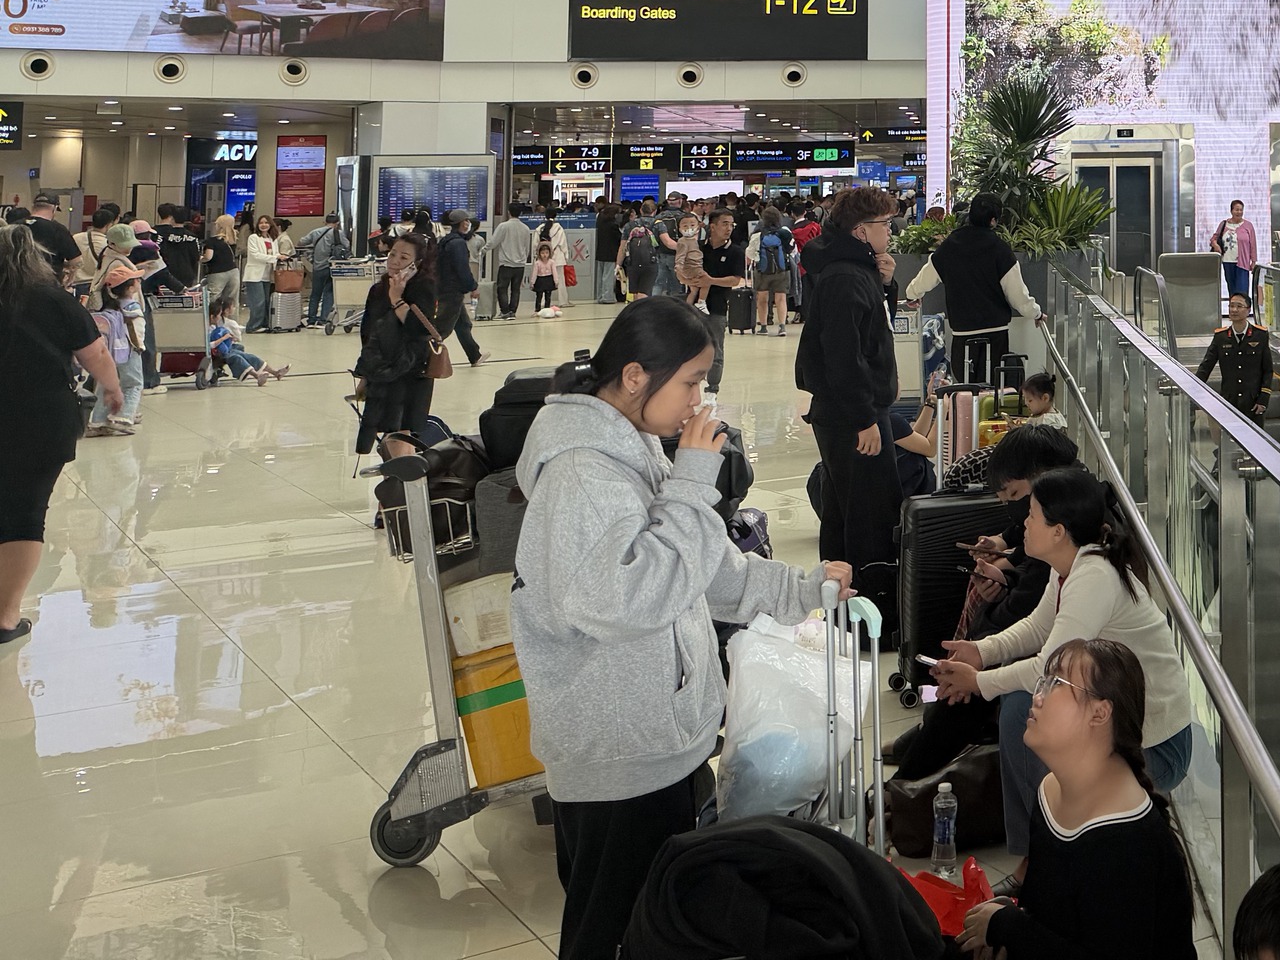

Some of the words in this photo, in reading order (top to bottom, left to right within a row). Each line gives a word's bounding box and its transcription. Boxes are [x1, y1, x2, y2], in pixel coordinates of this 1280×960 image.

[581, 6, 636, 22] Boarding
[640, 6, 677, 20] Gates
[215, 143, 258, 161] ACV
[581, 147, 600, 157] 7-9
[690, 145, 708, 155] 4-6
[797, 150, 811, 161] 3F
[574, 161, 606, 171] 10-17
[690, 159, 707, 169] 1-3
